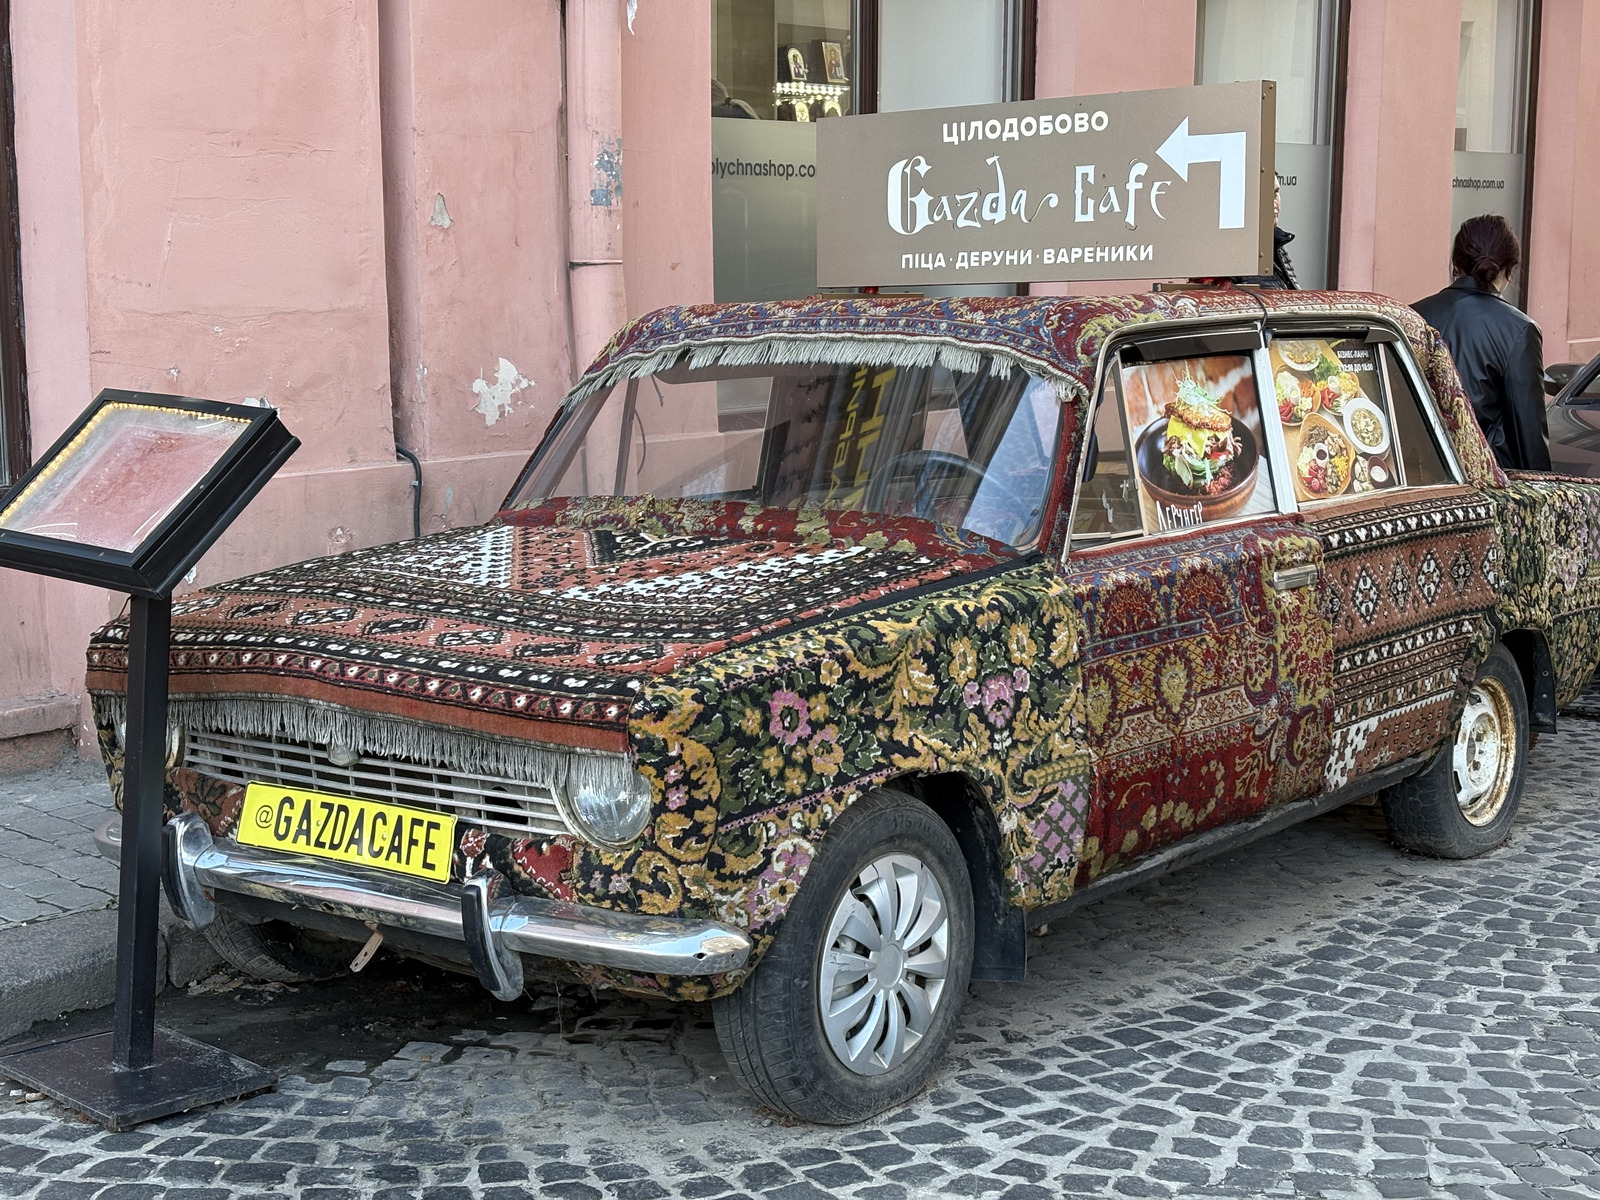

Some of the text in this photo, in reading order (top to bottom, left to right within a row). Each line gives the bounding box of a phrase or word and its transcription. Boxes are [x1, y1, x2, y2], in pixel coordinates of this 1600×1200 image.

[942, 110, 1109, 146] ЦІЛОДОБОВО
[887, 154, 1172, 236] Gazda Cafe
[901, 244, 1154, 271] ПІЦА ДЕРУНИ ВАРЕНИКИ
[255, 796, 441, 871] @GAZDACAFE
